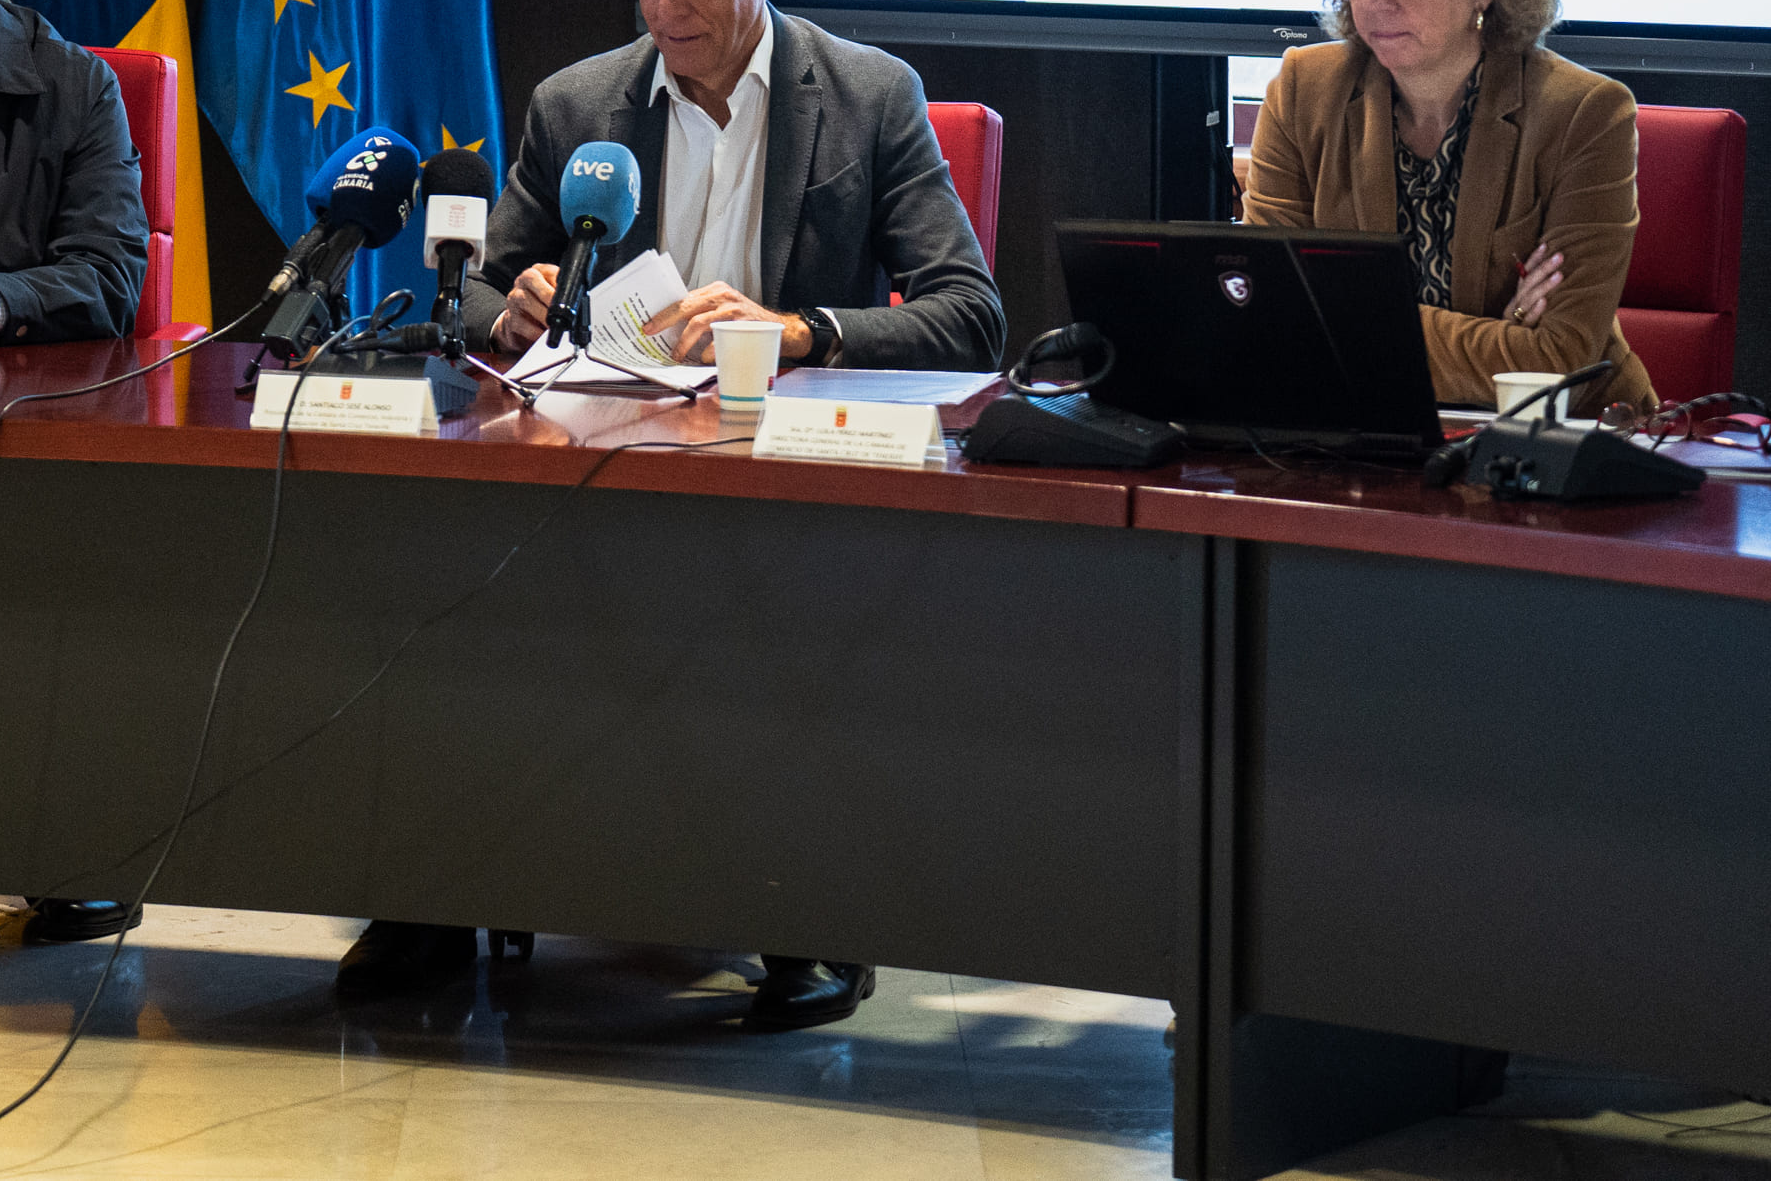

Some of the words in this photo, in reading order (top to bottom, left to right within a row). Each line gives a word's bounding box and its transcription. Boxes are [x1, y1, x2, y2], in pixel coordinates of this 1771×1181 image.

[1280, 29, 1308, 40] Optoma
[572, 158, 615, 181] tve
[332, 178, 374, 192] CANARIA
